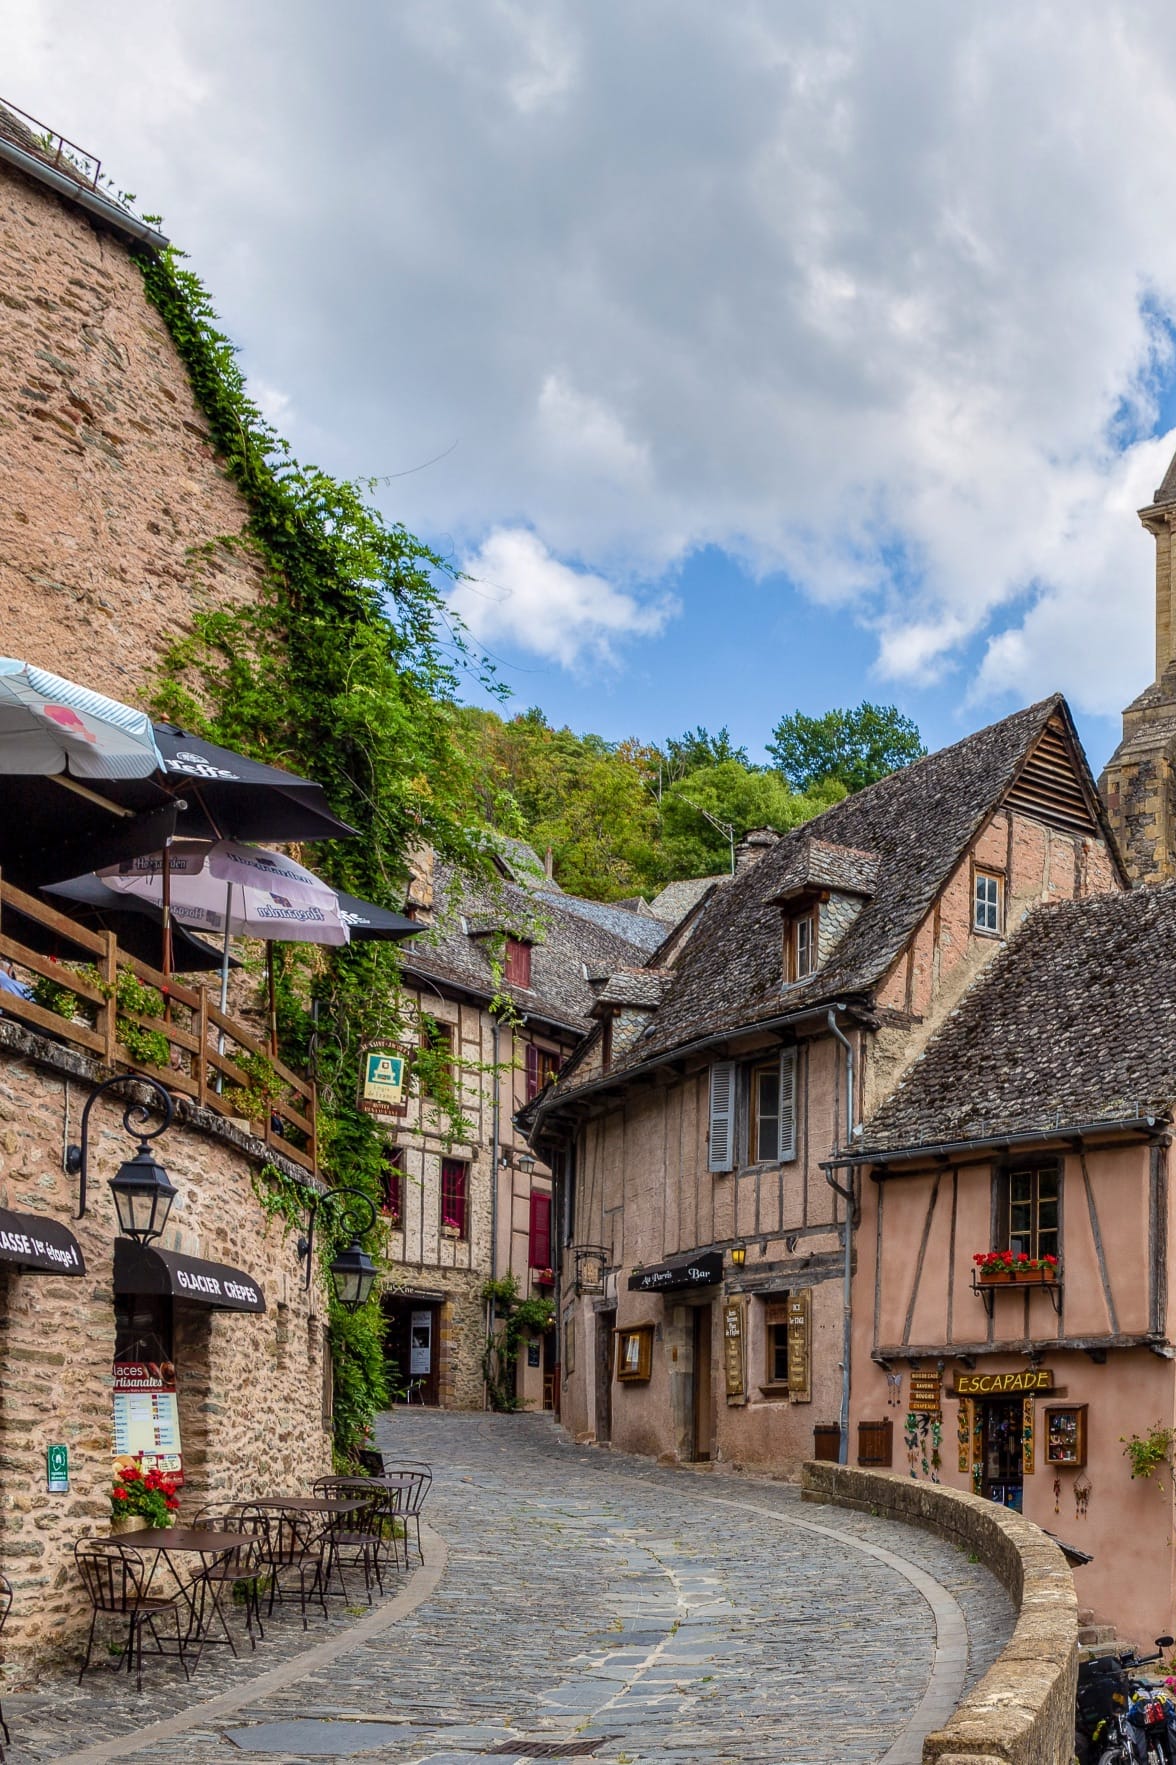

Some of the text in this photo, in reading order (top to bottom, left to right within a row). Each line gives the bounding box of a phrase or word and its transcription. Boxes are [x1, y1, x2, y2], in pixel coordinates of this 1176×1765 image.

[688, 1268, 711, 1280] Bar
[177, 1270, 221, 1296] GLACIER
[113, 1363, 144, 1376] laces
[114, 1376, 163, 1388] rtisanales
[958, 1372, 1049, 1393] ESCAPADE
